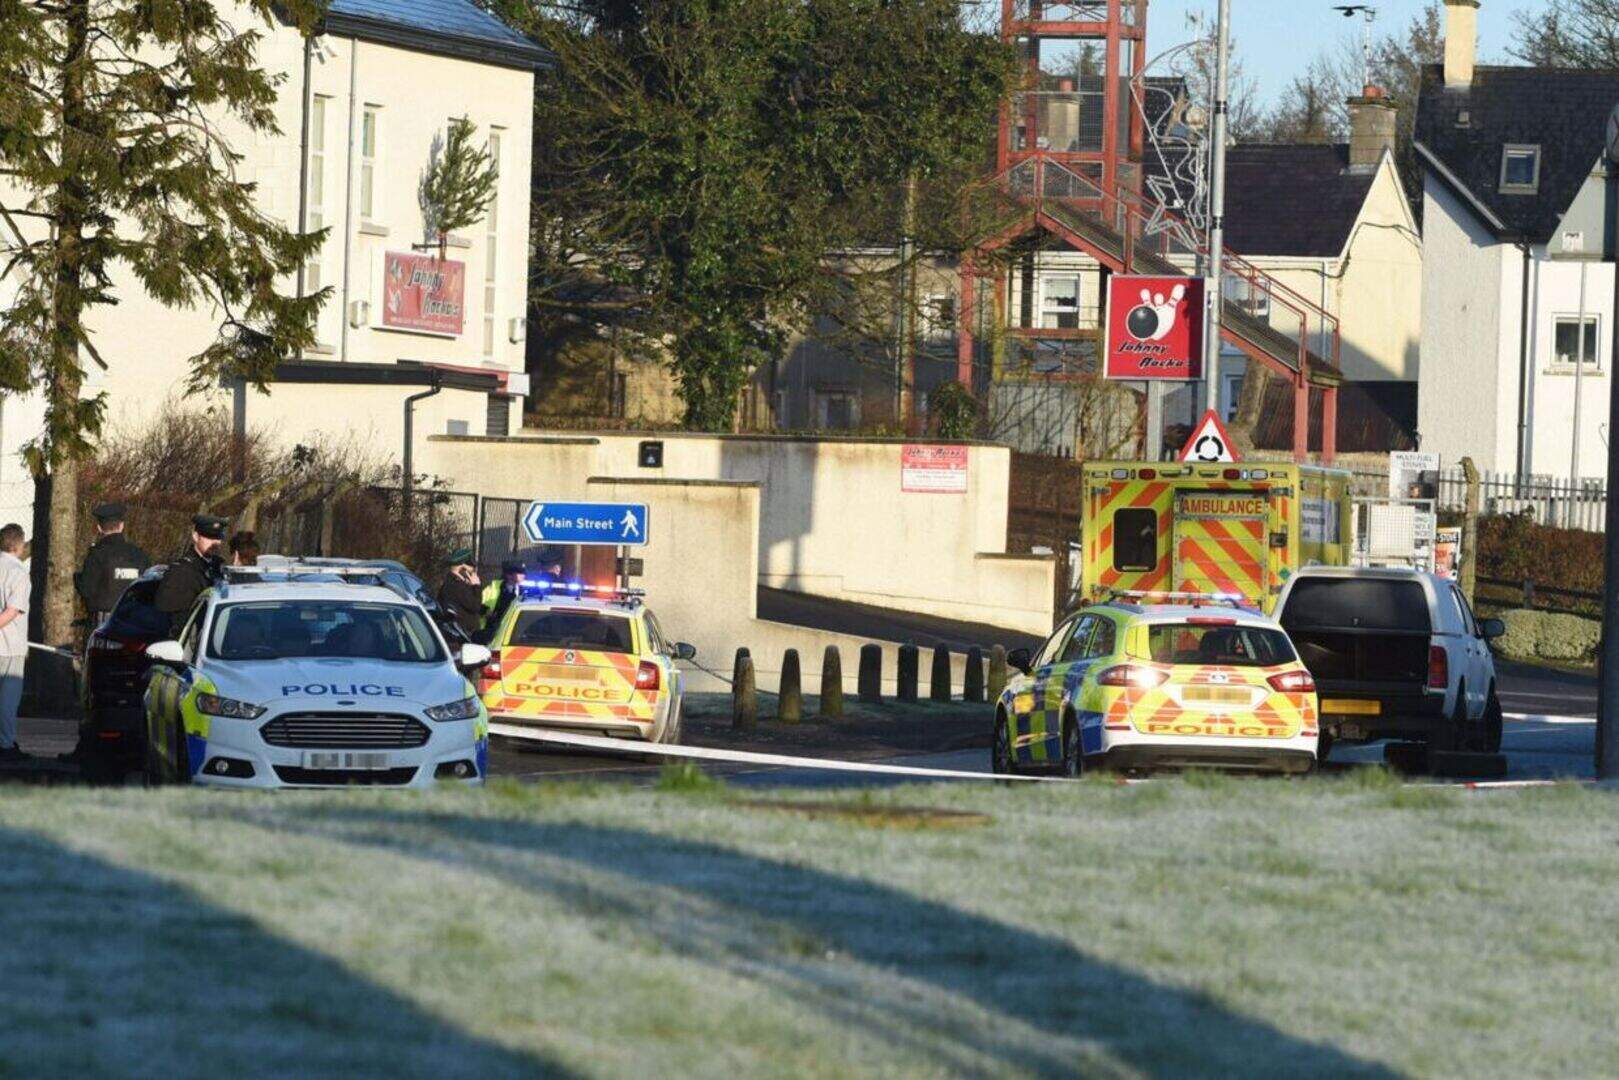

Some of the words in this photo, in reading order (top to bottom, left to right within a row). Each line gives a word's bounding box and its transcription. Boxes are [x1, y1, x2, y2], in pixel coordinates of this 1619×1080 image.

[1118, 341, 1168, 354] Johnny
[1182, 498, 1263, 515] AMBULANCE
[544, 517, 573, 530] Main
[576, 517, 614, 530] Street
[281, 683, 406, 698] POLICE
[515, 683, 621, 699] POLICE
[1147, 723, 1291, 736] POLICE
